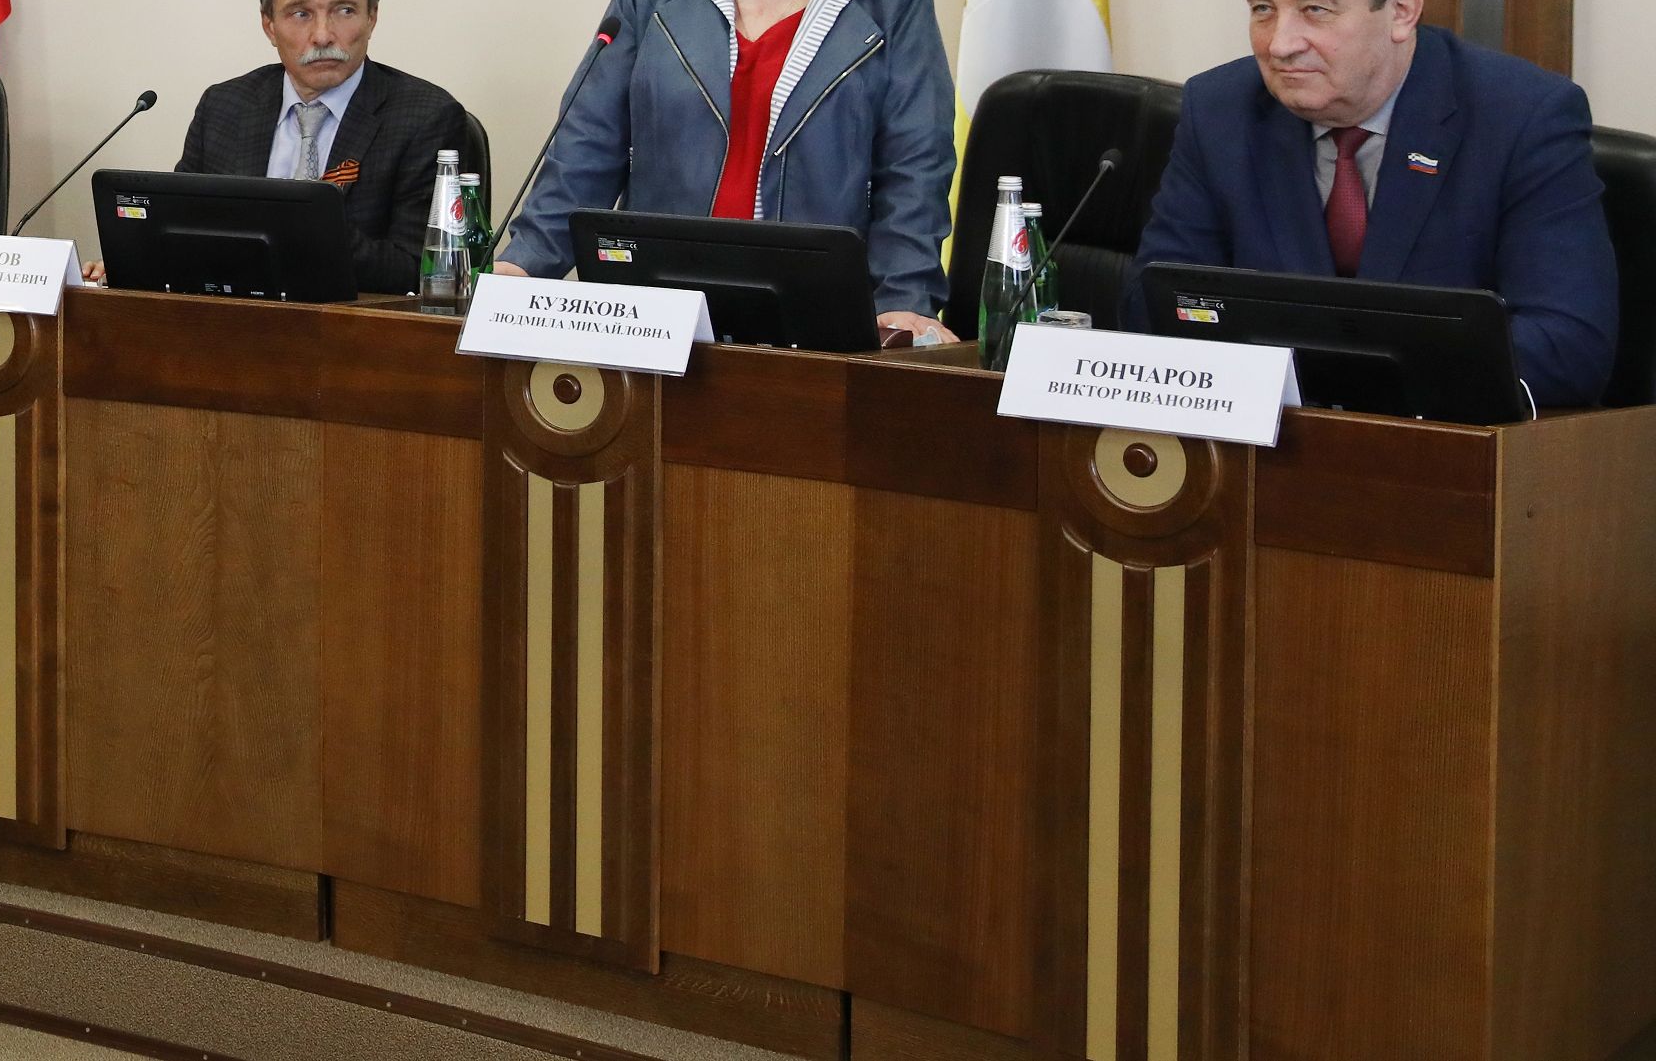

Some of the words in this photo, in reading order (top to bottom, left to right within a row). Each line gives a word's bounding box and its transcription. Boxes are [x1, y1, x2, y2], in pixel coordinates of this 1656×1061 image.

[528, 294, 640, 320] КУЗЯКОВА
[489, 311, 565, 330] ЛЮДМИЛА
[567, 319, 672, 341] МИХАЙЛОВНА
[1075, 358, 1214, 390] ГОНЧАРОВ
[1046, 380, 1122, 401] ВИКТОР
[1125, 389, 1234, 414] ИВАНОВИЧ
